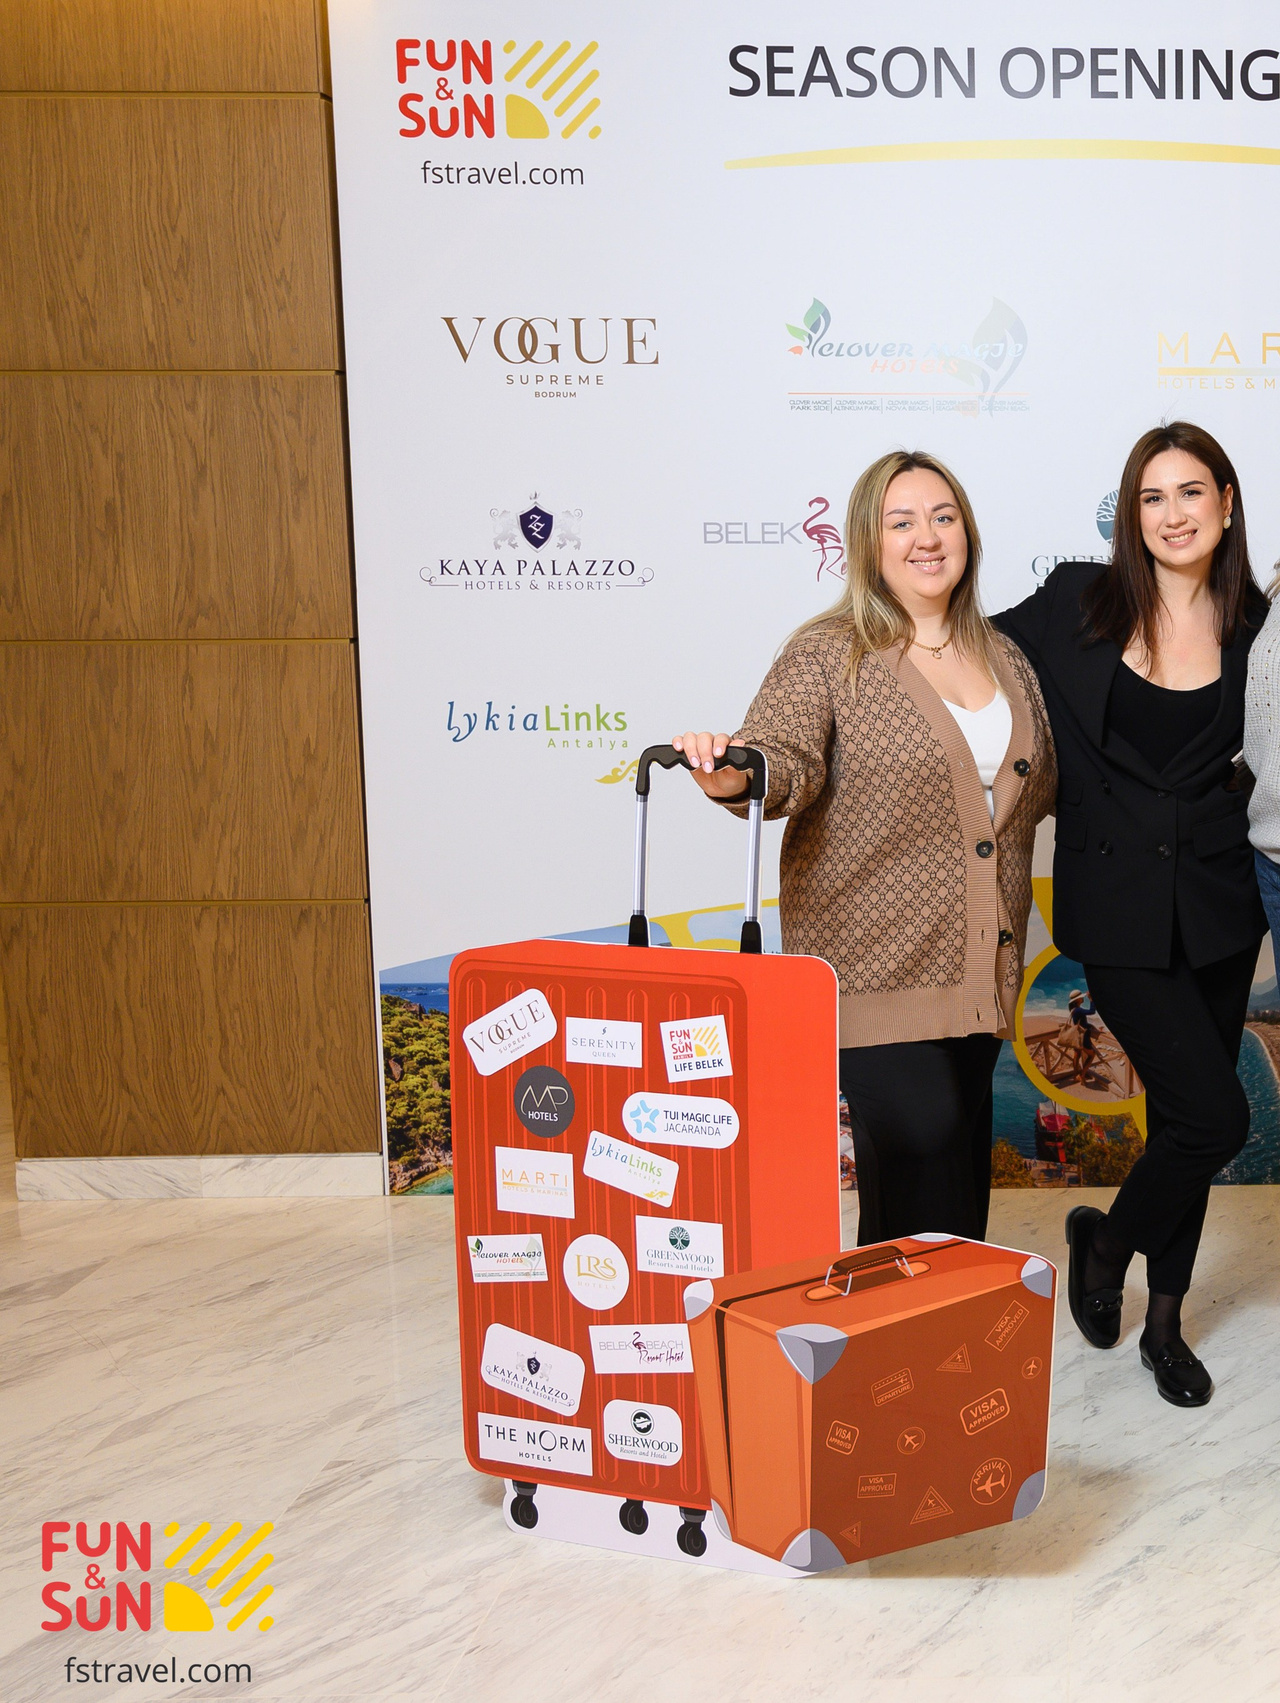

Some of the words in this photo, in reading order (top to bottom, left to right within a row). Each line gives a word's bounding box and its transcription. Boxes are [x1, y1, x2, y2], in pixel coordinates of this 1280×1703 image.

[395, 38, 493, 85] FUN
[728, 45, 976, 99] SEASON
[1000, 46, 1280, 101] OPENING
[435, 77, 454, 100] &
[398, 93, 495, 139] SUN
[420, 160, 584, 185] fstravel.com
[440, 316, 660, 365] VOGUE
[818, 342, 914, 358] CLOVER
[506, 374, 605, 386] SUPREME
[1157, 377, 1235, 389] HOTELS
[1244, 377, 1255, 389] &
[704, 522, 803, 545] BELEK
[439, 559, 506, 576] KAYA
[517, 559, 635, 577] PALAZZO
[465, 580, 521, 590] HOTELS
[529, 579, 539, 590] &
[548, 581, 611, 590] RESORTS
[547, 738, 628, 750] Antalya
[469, 999, 546, 1053] VOGUE
[499, 1031, 532, 1054] SUPREME
[571, 1037, 637, 1051] SERENITY
[669, 1029, 691, 1042] FUN
[674, 1062, 693, 1072] LIFE
[695, 1059, 724, 1070] BELEK
[528, 1111, 559, 1122] HOTELS
[663, 1110, 679, 1120] TUI
[681, 1111, 711, 1123] MAGIC
[713, 1115, 732, 1125] LIFE
[663, 1123, 721, 1137] JACARANDA
[502, 1168, 568, 1187] MARTI
[646, 1249, 715, 1265] GREENWOOD
[576, 1254, 618, 1281] LRS
[648, 1260, 674, 1268] Resorts
[690, 1264, 714, 1272] Hotels
[995, 1315, 1011, 1333] VISA
[995, 1308, 1024, 1347] APPROVED
[599, 1341, 633, 1351] BELEK
[646, 1340, 684, 1350] BEACH
[493, 1364, 519, 1382] KAYA
[522, 1376, 569, 1401] PALAZZO
[501, 1377, 523, 1390] HOTELS
[877, 1384, 911, 1404] DEPARTURE
[970, 1398, 998, 1419] VISA
[968, 1405, 1005, 1430] APPROVED
[485, 1424, 517, 1442] THE
[527, 1429, 586, 1452] NORM
[835, 1426, 851, 1441] VISA
[608, 1433, 679, 1453] SHERWOOD
[829, 1436, 852, 1450] APPROVED
[518, 1451, 552, 1462] HOTELS
[619, 1447, 638, 1456] Resorts
[650, 1451, 668, 1460] Hotels
[868, 1476, 884, 1484] VISA
[973, 1460, 1007, 1485] ARRIVAL
[860, 1483, 894, 1492] APPROVED
